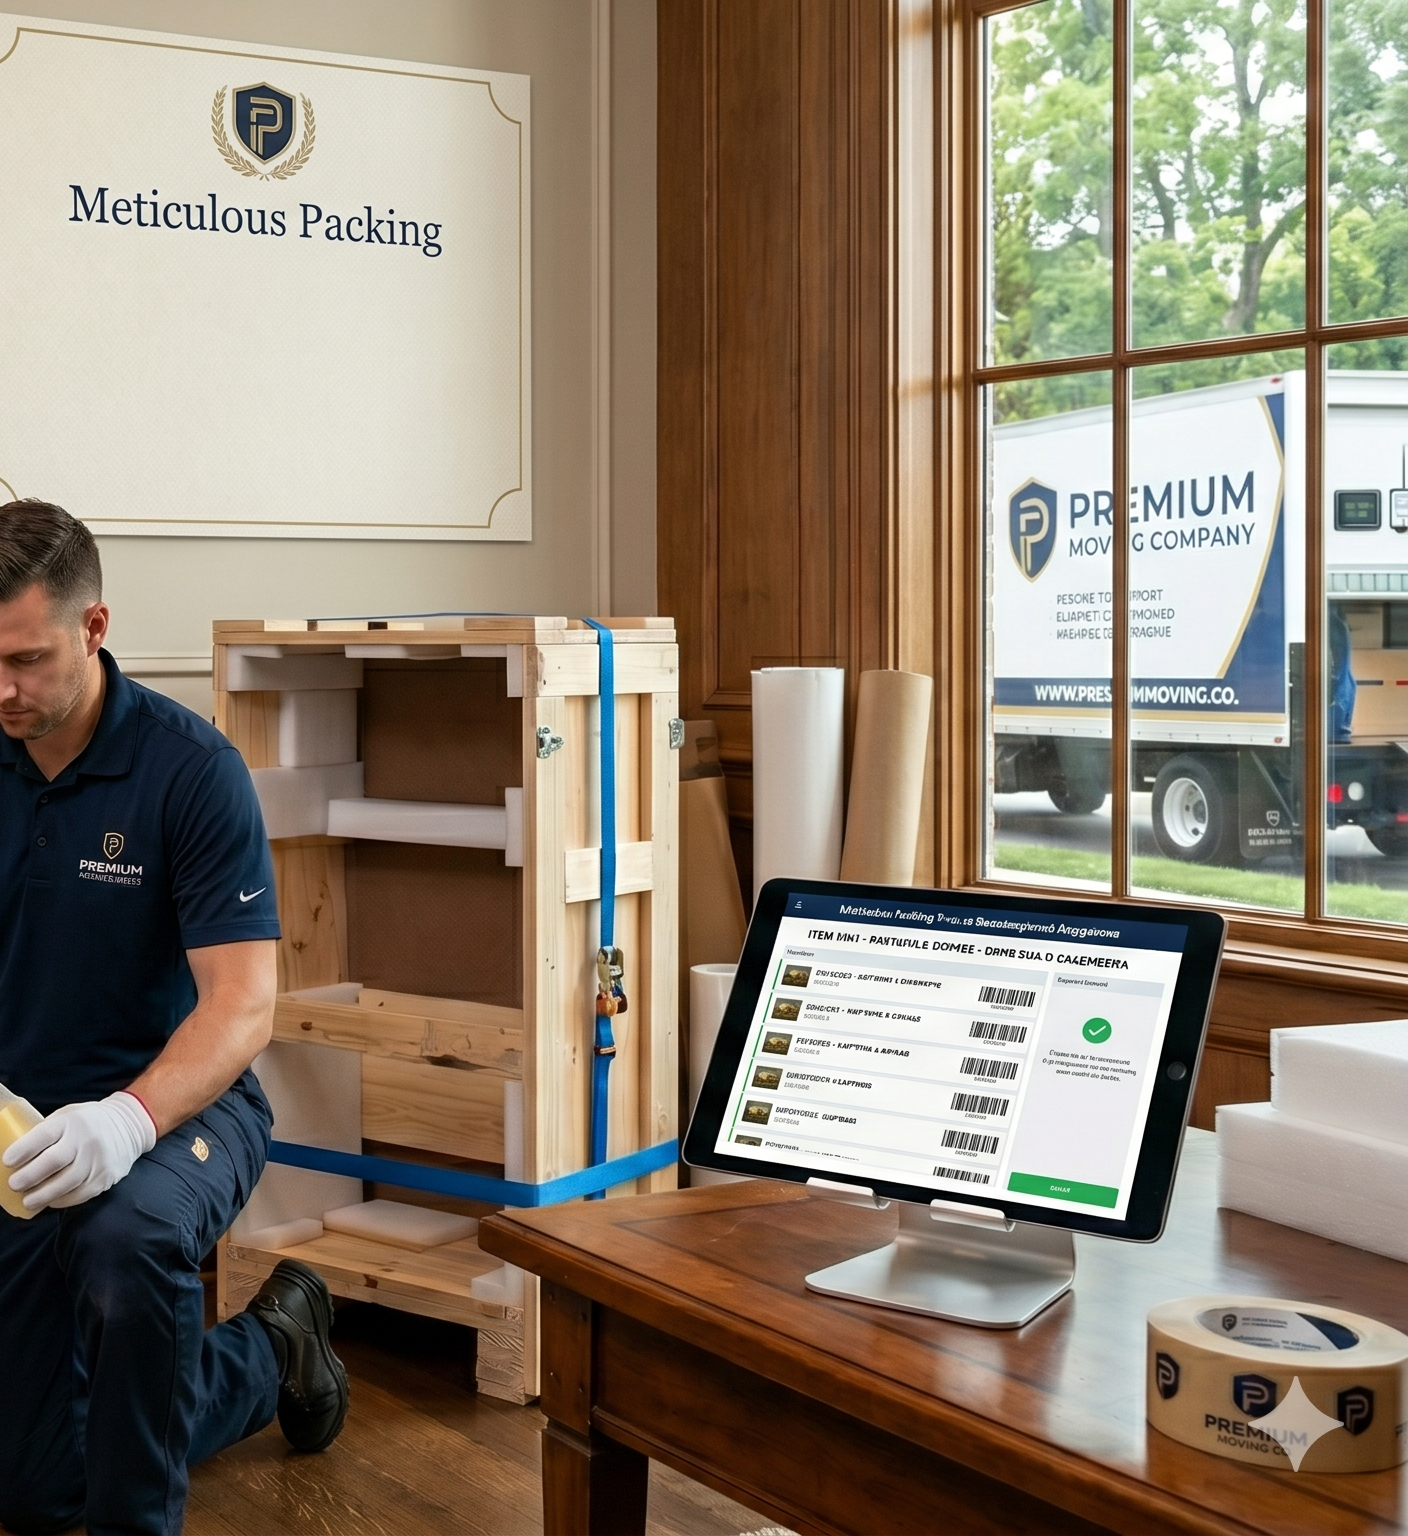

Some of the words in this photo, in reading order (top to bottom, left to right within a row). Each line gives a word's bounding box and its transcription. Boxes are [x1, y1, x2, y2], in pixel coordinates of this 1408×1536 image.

[69, 184, 286, 236] Meticulous
[299, 203, 442, 258] Packing
[1069, 532, 1143, 557] MOVG
[1150, 522, 1255, 550] COMPANY
[79, 859, 143, 876] PREMIUM
[808, 929, 834, 941] ITEM
[1205, 1413, 1308, 1447] PREMIUM
[1217, 1434, 1269, 1454] MOVING
